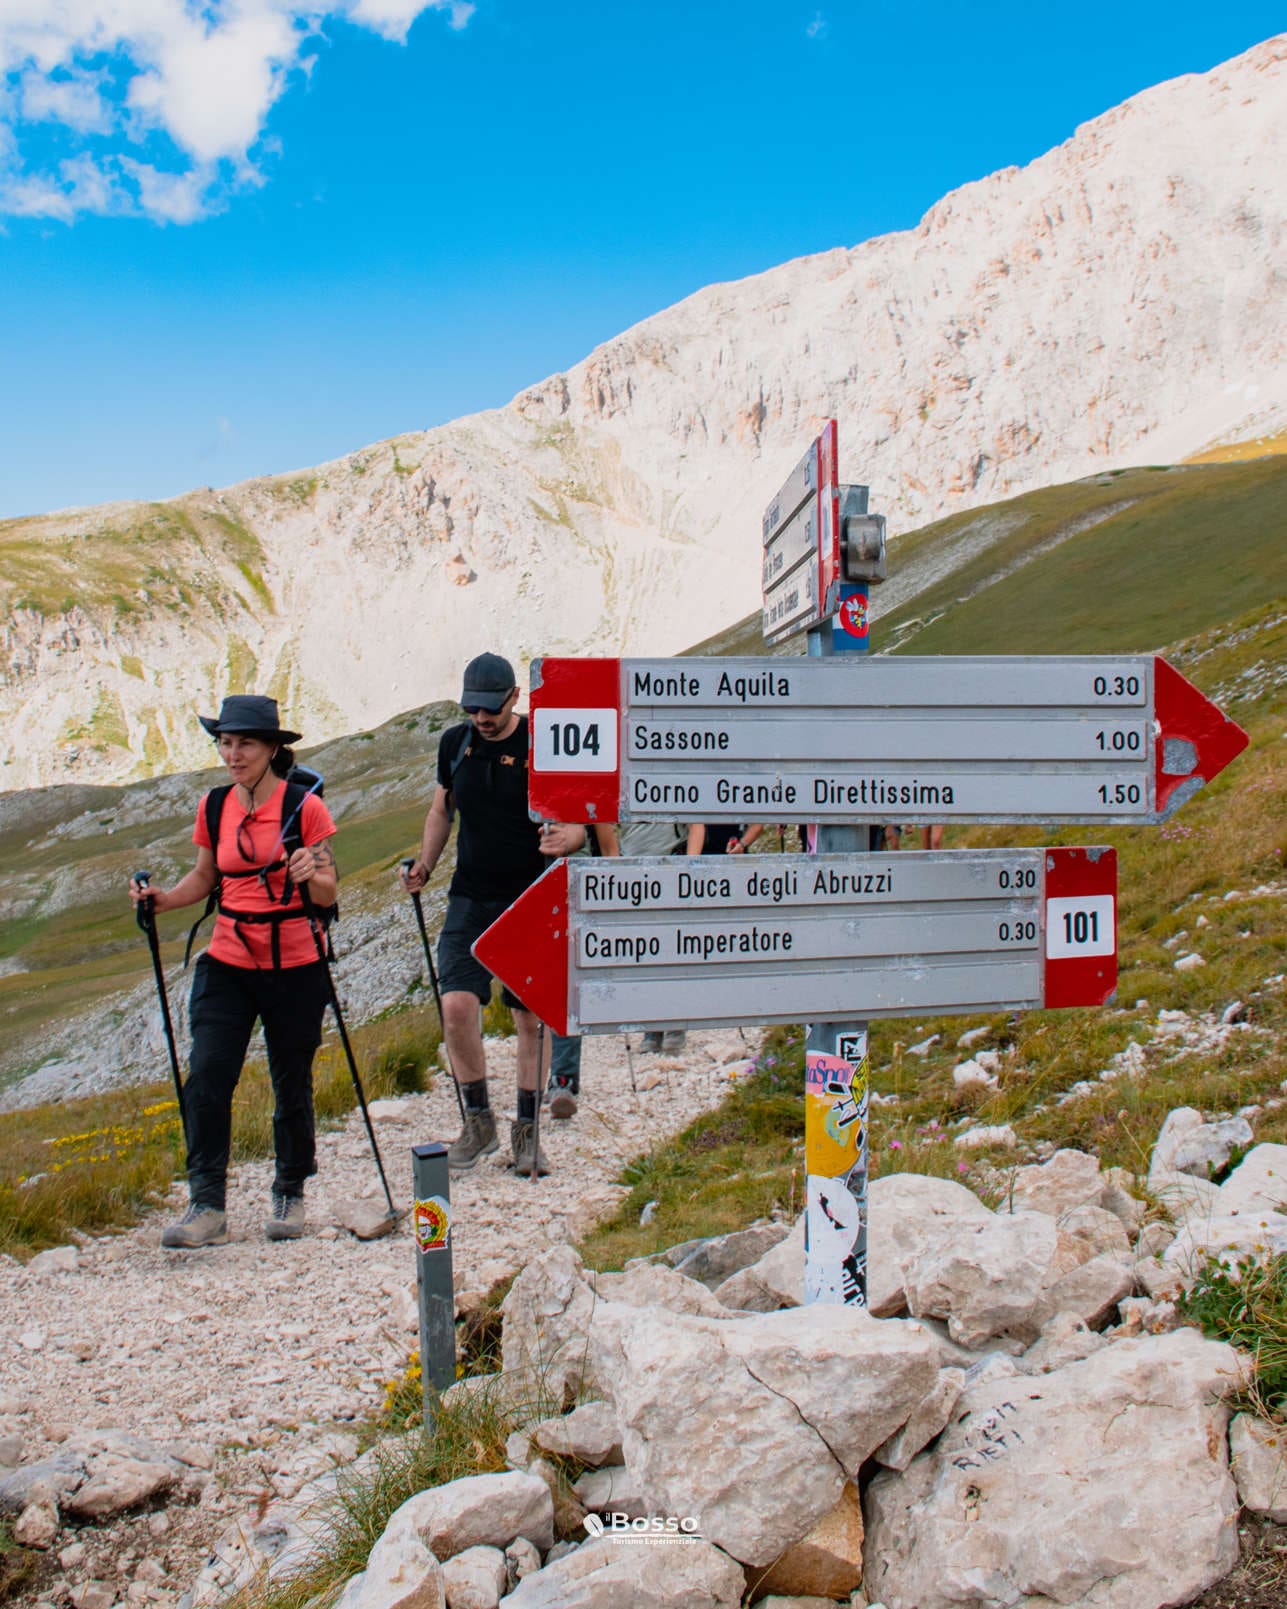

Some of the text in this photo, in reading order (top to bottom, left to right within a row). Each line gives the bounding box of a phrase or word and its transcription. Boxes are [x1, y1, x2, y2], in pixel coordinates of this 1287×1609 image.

[634, 671, 1140, 703] Monte Aquila 0.30
[550, 722, 601, 757] 104
[634, 725, 1140, 751] Sassone 1.00
[634, 778, 1141, 805] Corno Grande Direttissima 1.50
[585, 868, 1036, 907] Rifugio Duca degli Abruzzi 0.30
[584, 921, 1036, 963] Campo Imperatore 0.30
[1062, 910, 1099, 944] 101
